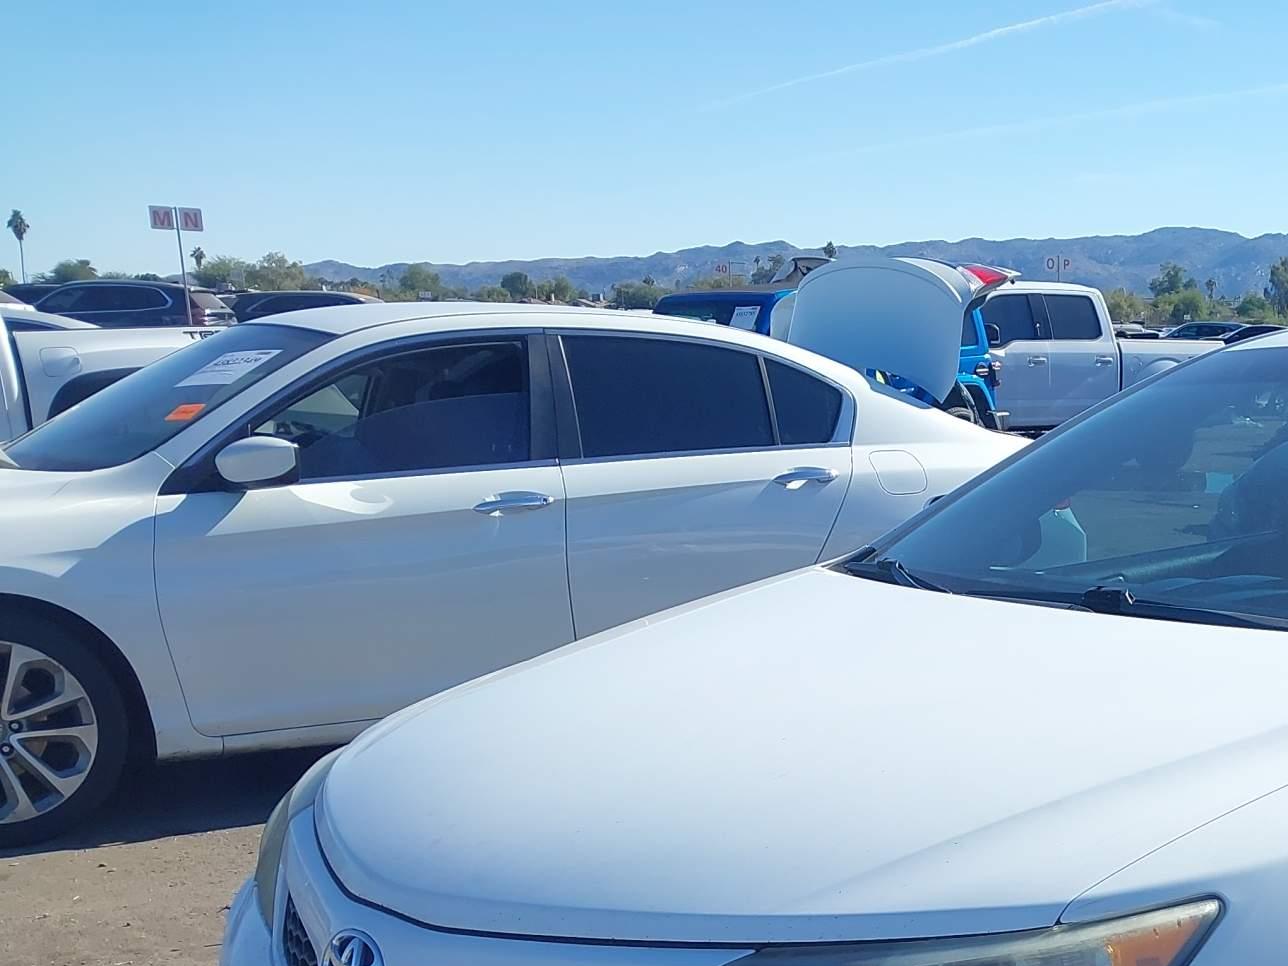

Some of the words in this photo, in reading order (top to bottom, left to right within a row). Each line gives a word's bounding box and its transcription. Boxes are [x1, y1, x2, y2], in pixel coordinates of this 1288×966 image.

[152, 210, 172, 227] M
[183, 212, 199, 228] N
[715, 264, 727, 273] 40
[1046, 257, 1055, 270] O
[1063, 259, 1070, 270] P
[182, 330, 221, 340] TR
